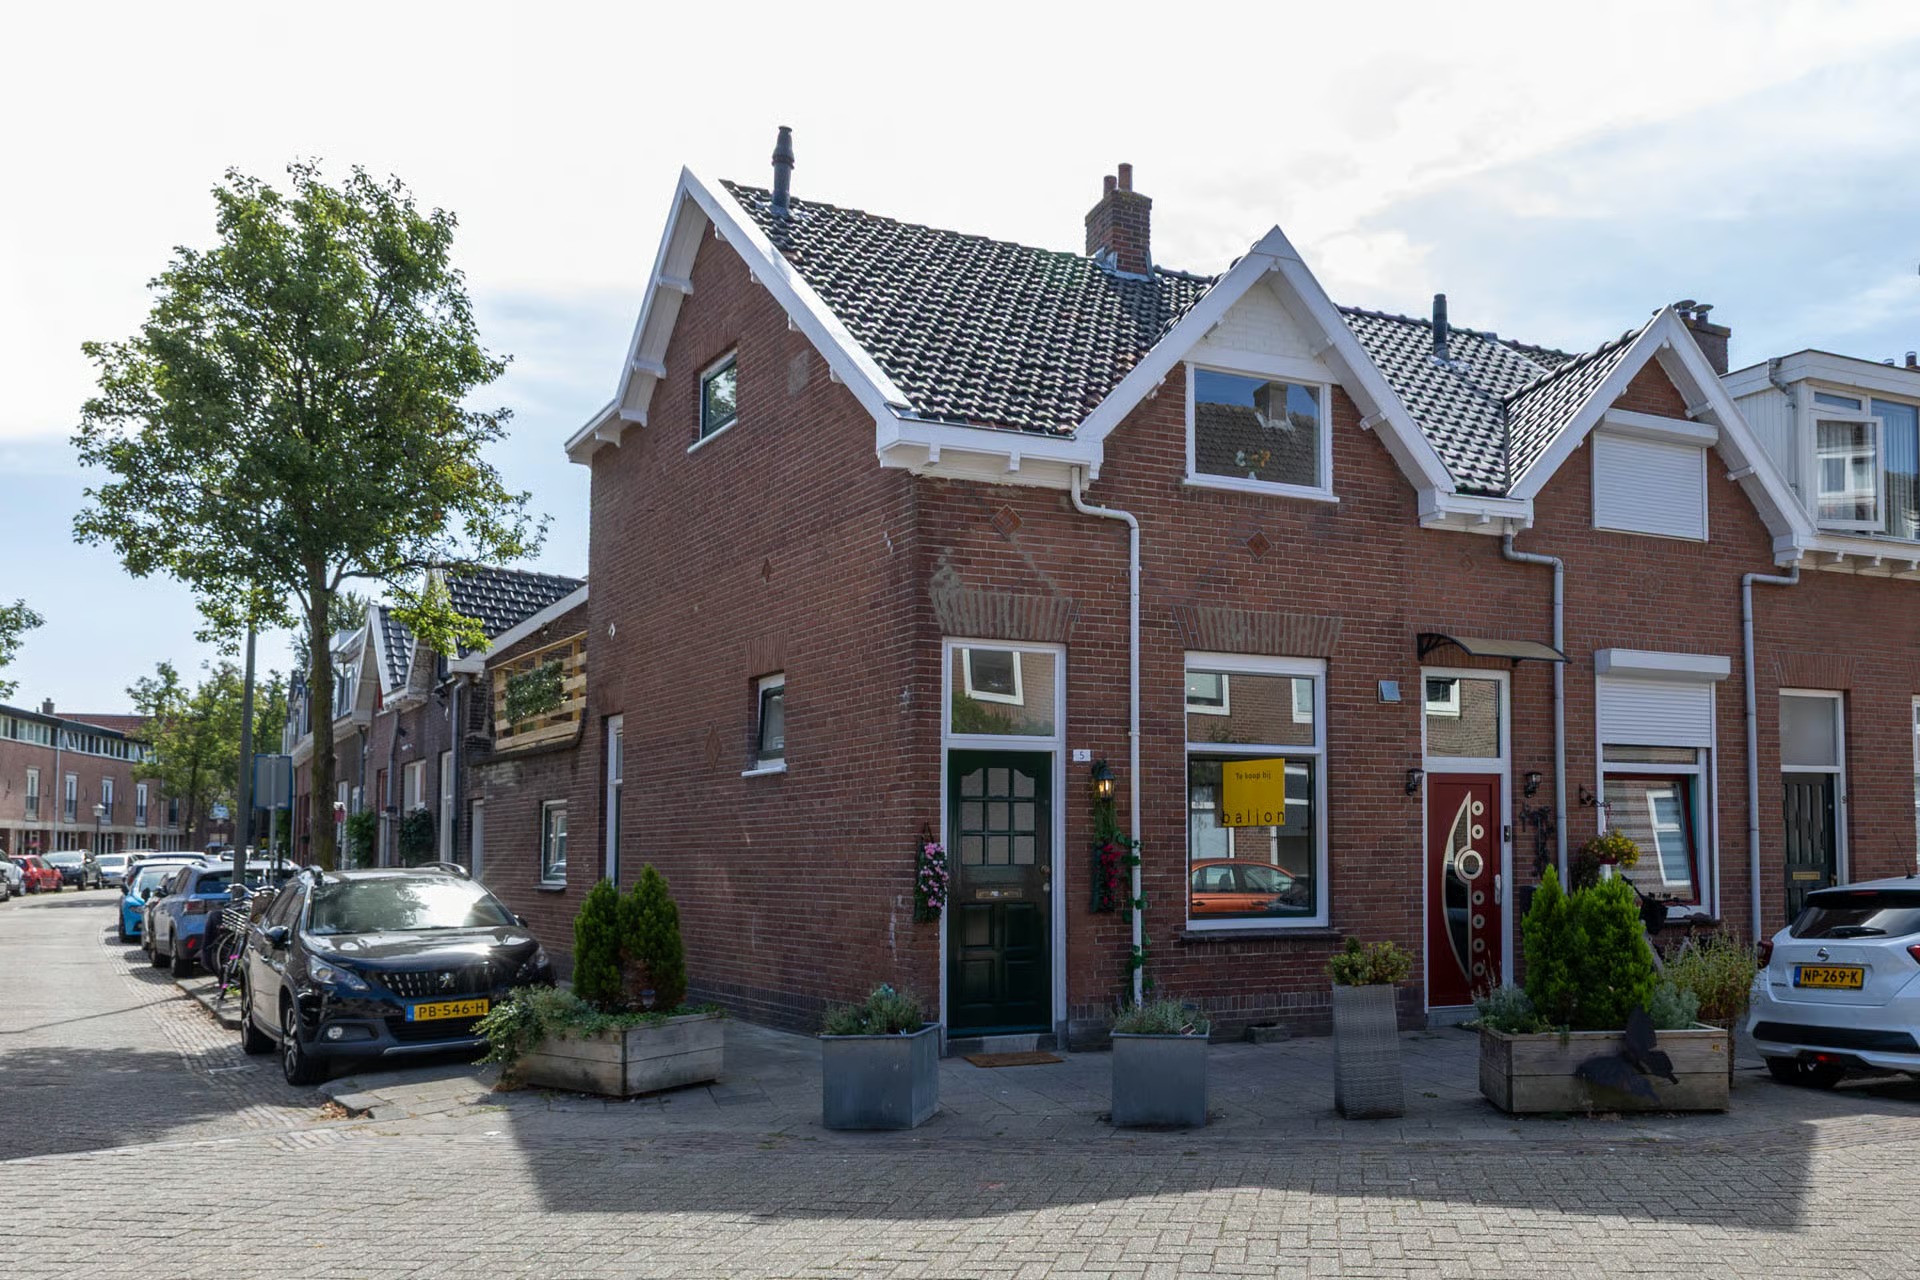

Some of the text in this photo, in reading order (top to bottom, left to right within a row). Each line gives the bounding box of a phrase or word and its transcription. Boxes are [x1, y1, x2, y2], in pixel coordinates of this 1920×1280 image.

[1079, 751, 1085, 760] 5
[1245, 771, 1261, 780] koop
[1222, 808, 1285, 826] baljon
[1804, 969, 1859, 984] NP-269-K
[418, 1001, 484, 1018] PB-546-H
